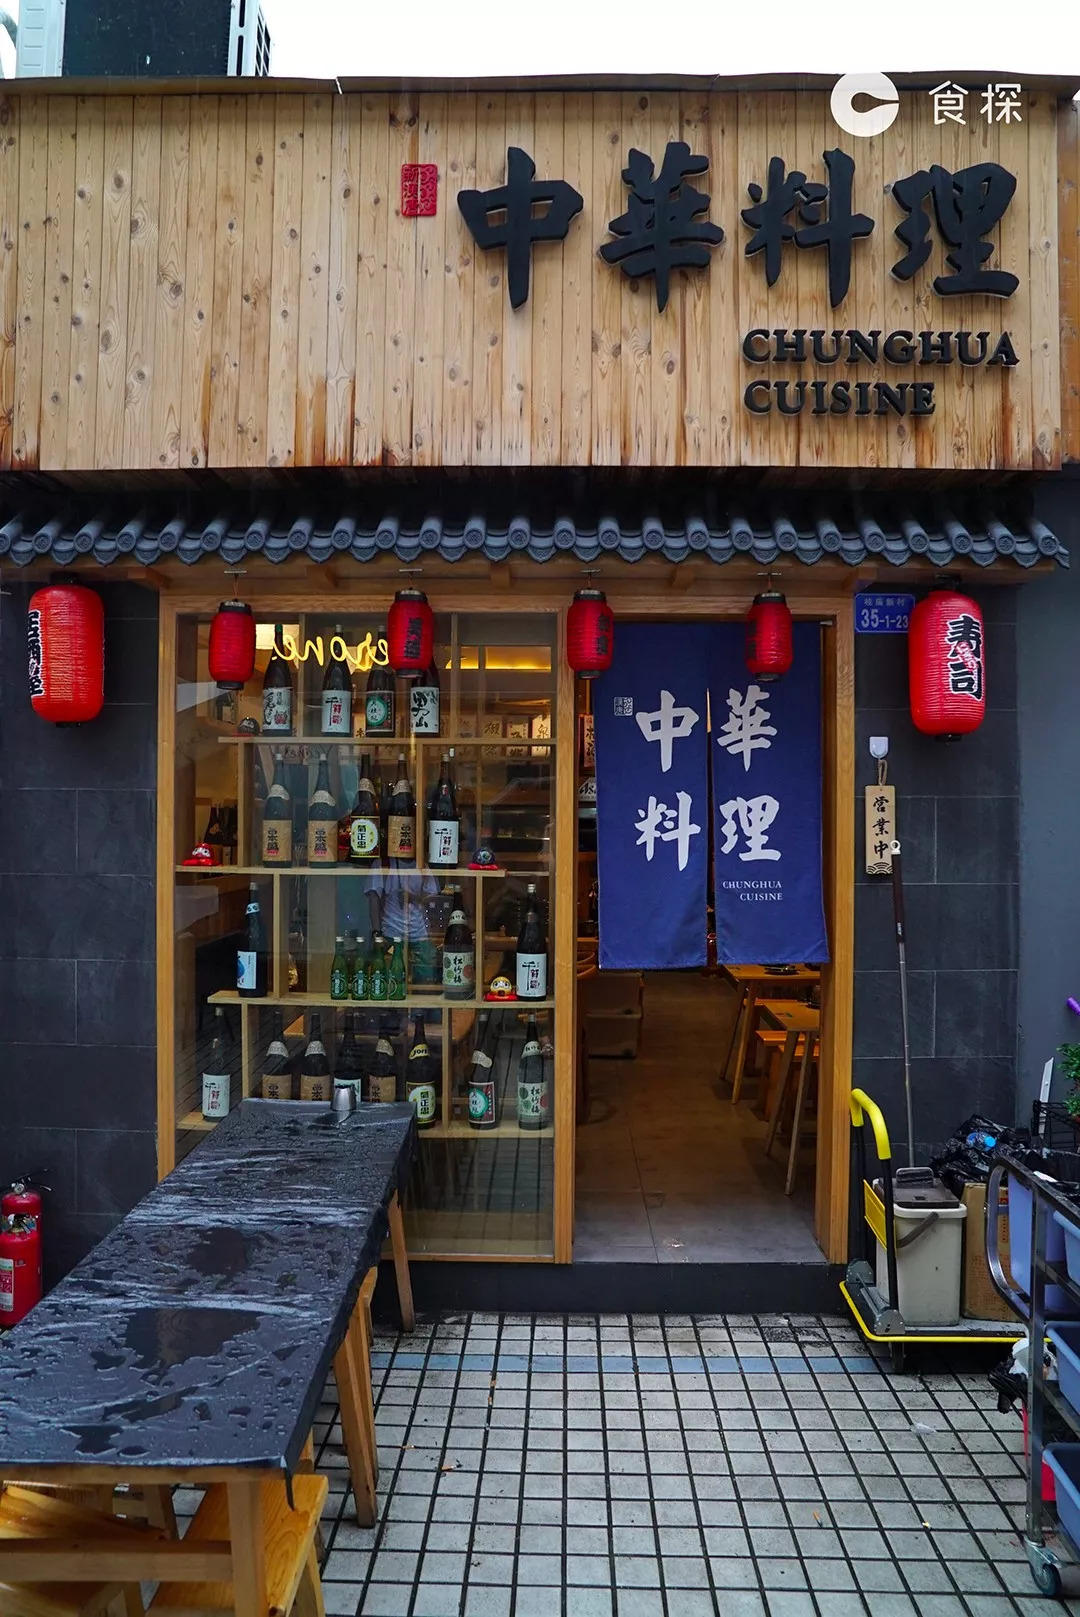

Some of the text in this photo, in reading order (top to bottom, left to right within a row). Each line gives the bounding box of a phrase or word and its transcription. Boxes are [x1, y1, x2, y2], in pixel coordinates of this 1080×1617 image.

[457, 142, 1020, 313] 中華料理
[742, 328, 1020, 366] CHUNGHUA
[743, 379, 937, 416] CUISINE
[860, 608, 909, 629] 35-1-23
[945, 613, 983, 701] 寿司
[579, 783, 597, 796] As
[722, 880, 782, 889] CHUNGHUA
[739, 892, 783, 901] CUISINE
[452, 955, 464, 984] 松竹梅
